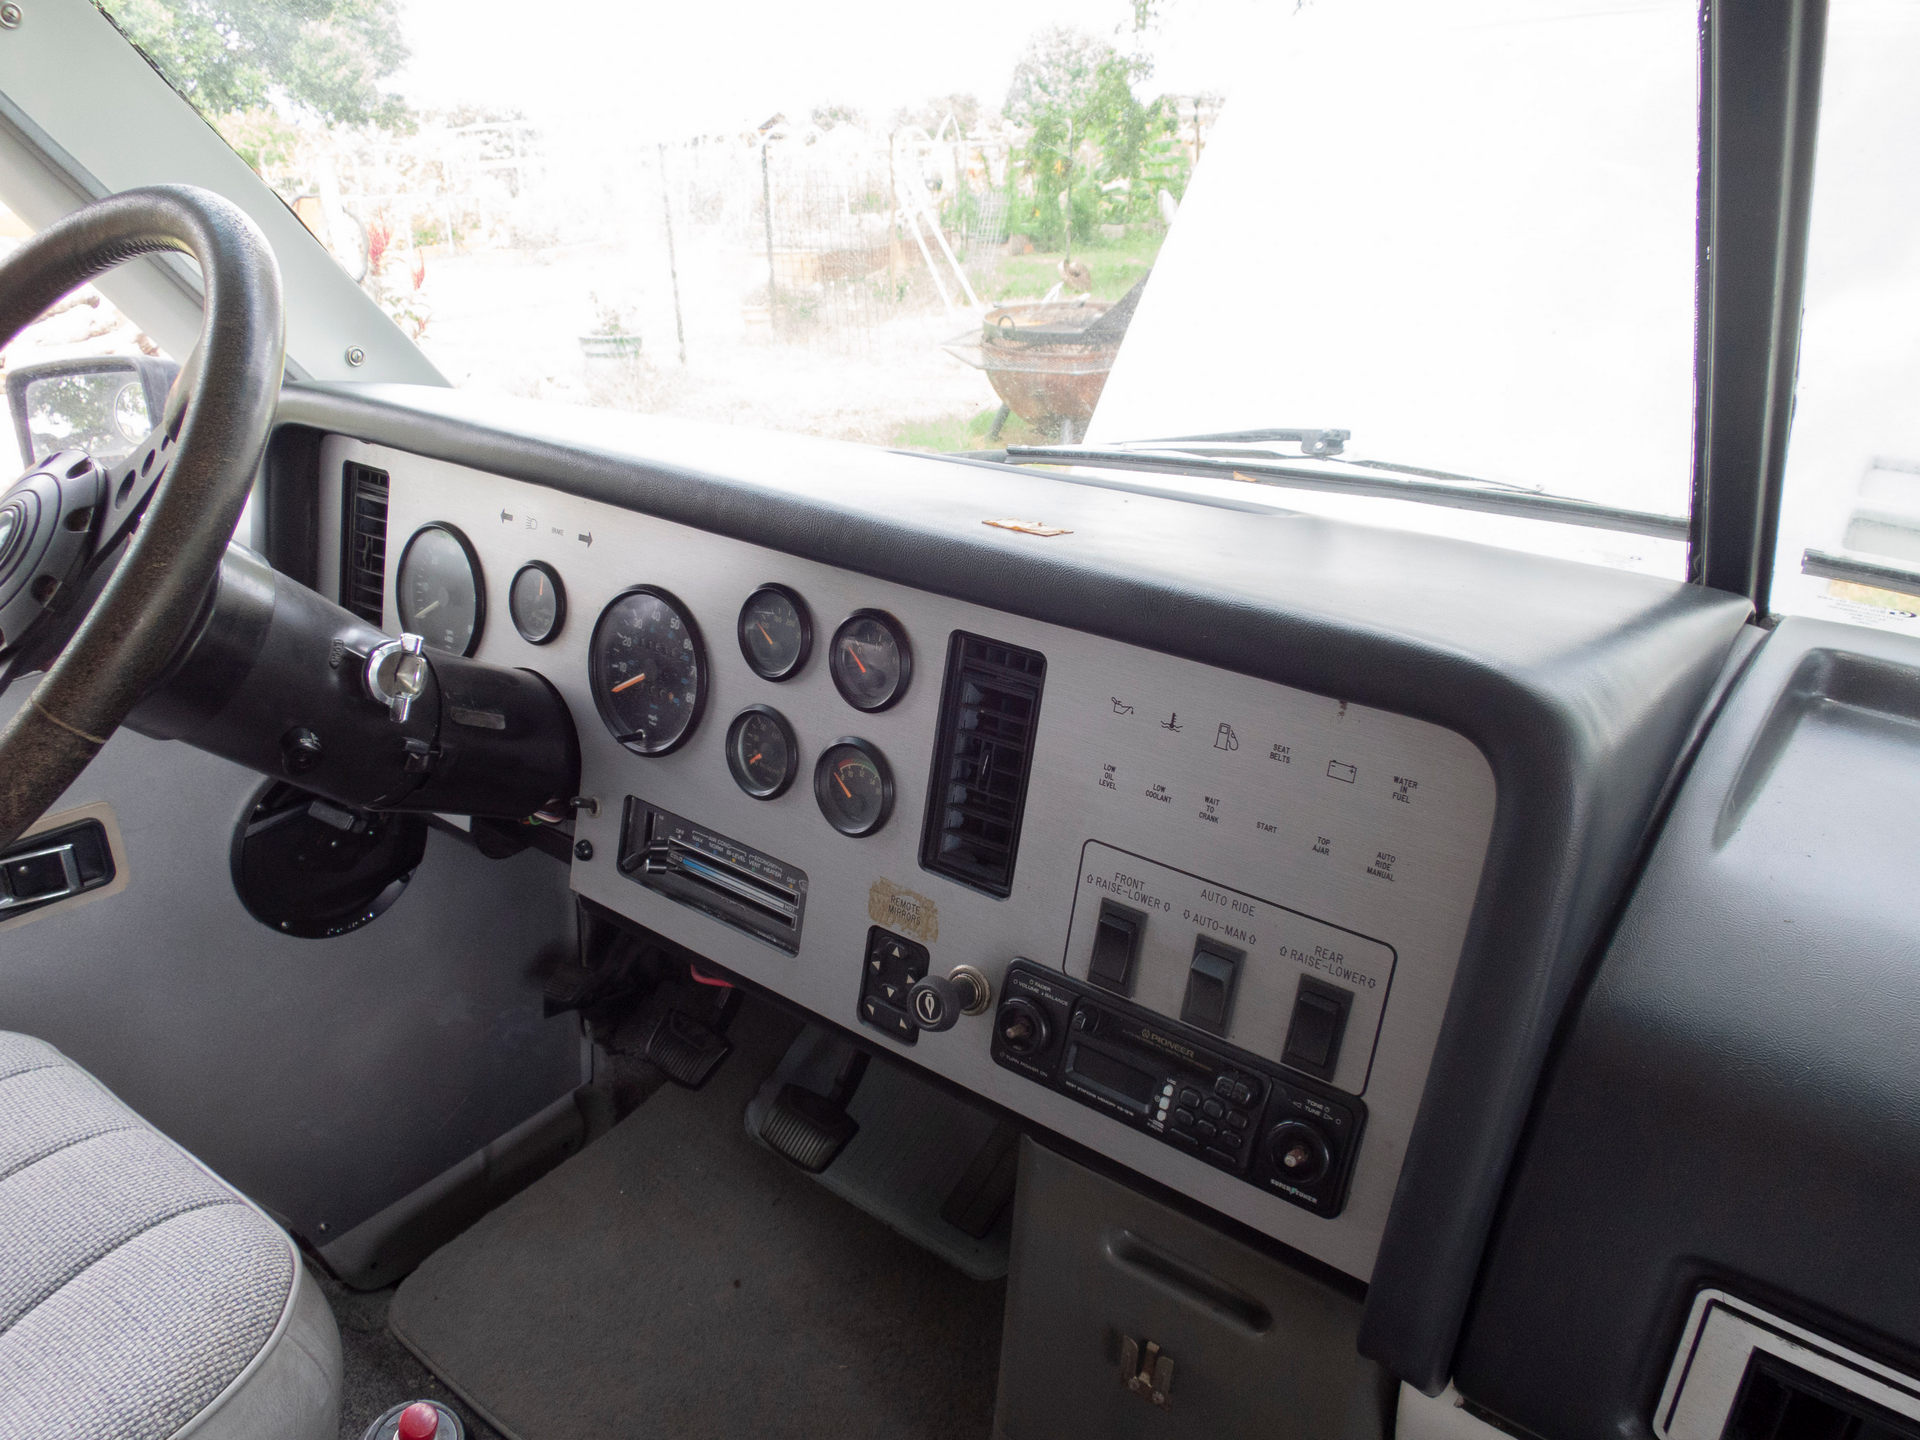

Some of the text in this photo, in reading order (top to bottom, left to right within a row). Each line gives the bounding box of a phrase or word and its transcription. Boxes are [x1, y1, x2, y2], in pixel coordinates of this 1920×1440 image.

[670, 618, 680, 630] 50
[622, 636, 632, 648] 20
[1272, 744, 1290, 754] SEAT
[1270, 752, 1290, 764] BELTS
[1104, 763, 1116, 773] LOW
[1104, 772, 1114, 781] OIL
[1393, 775, 1418, 790] WATER
[1098, 778, 1116, 790] LEVEL
[1152, 783, 1166, 793] LOW
[1400, 786, 1408, 794] IN
[1145, 790, 1172, 804] COOLANT
[1204, 796, 1220, 806] WAIT
[1392, 792, 1410, 804] FUEL
[1206, 805, 1215, 814] TO
[1198, 812, 1220, 824] CRANK
[1256, 822, 1278, 834] START
[1317, 836, 1331, 846] TOP
[1312, 844, 1330, 856] AJAR
[1376, 852, 1396, 864] AUTO
[1374, 860, 1392, 872] RIDE
[1366, 866, 1396, 882] MANUAL
[1114, 872, 1146, 891] FRONT
[1096, 876, 1161, 910] RAISE-LOWER
[890, 894, 921, 914] REMOTE
[1200, 888, 1256, 918] AUTO RIDE
[888, 904, 921, 926] MIRRORS
[1192, 913, 1247, 942] AUTO-MAN
[1314, 945, 1344, 965] REAR
[1290, 949, 1366, 986] RAISE-LOWER
[1151, 1033, 1194, 1058] PIONEER
[1306, 1099, 1324, 1110] TONE
[1305, 1106, 1322, 1118] TUNE
